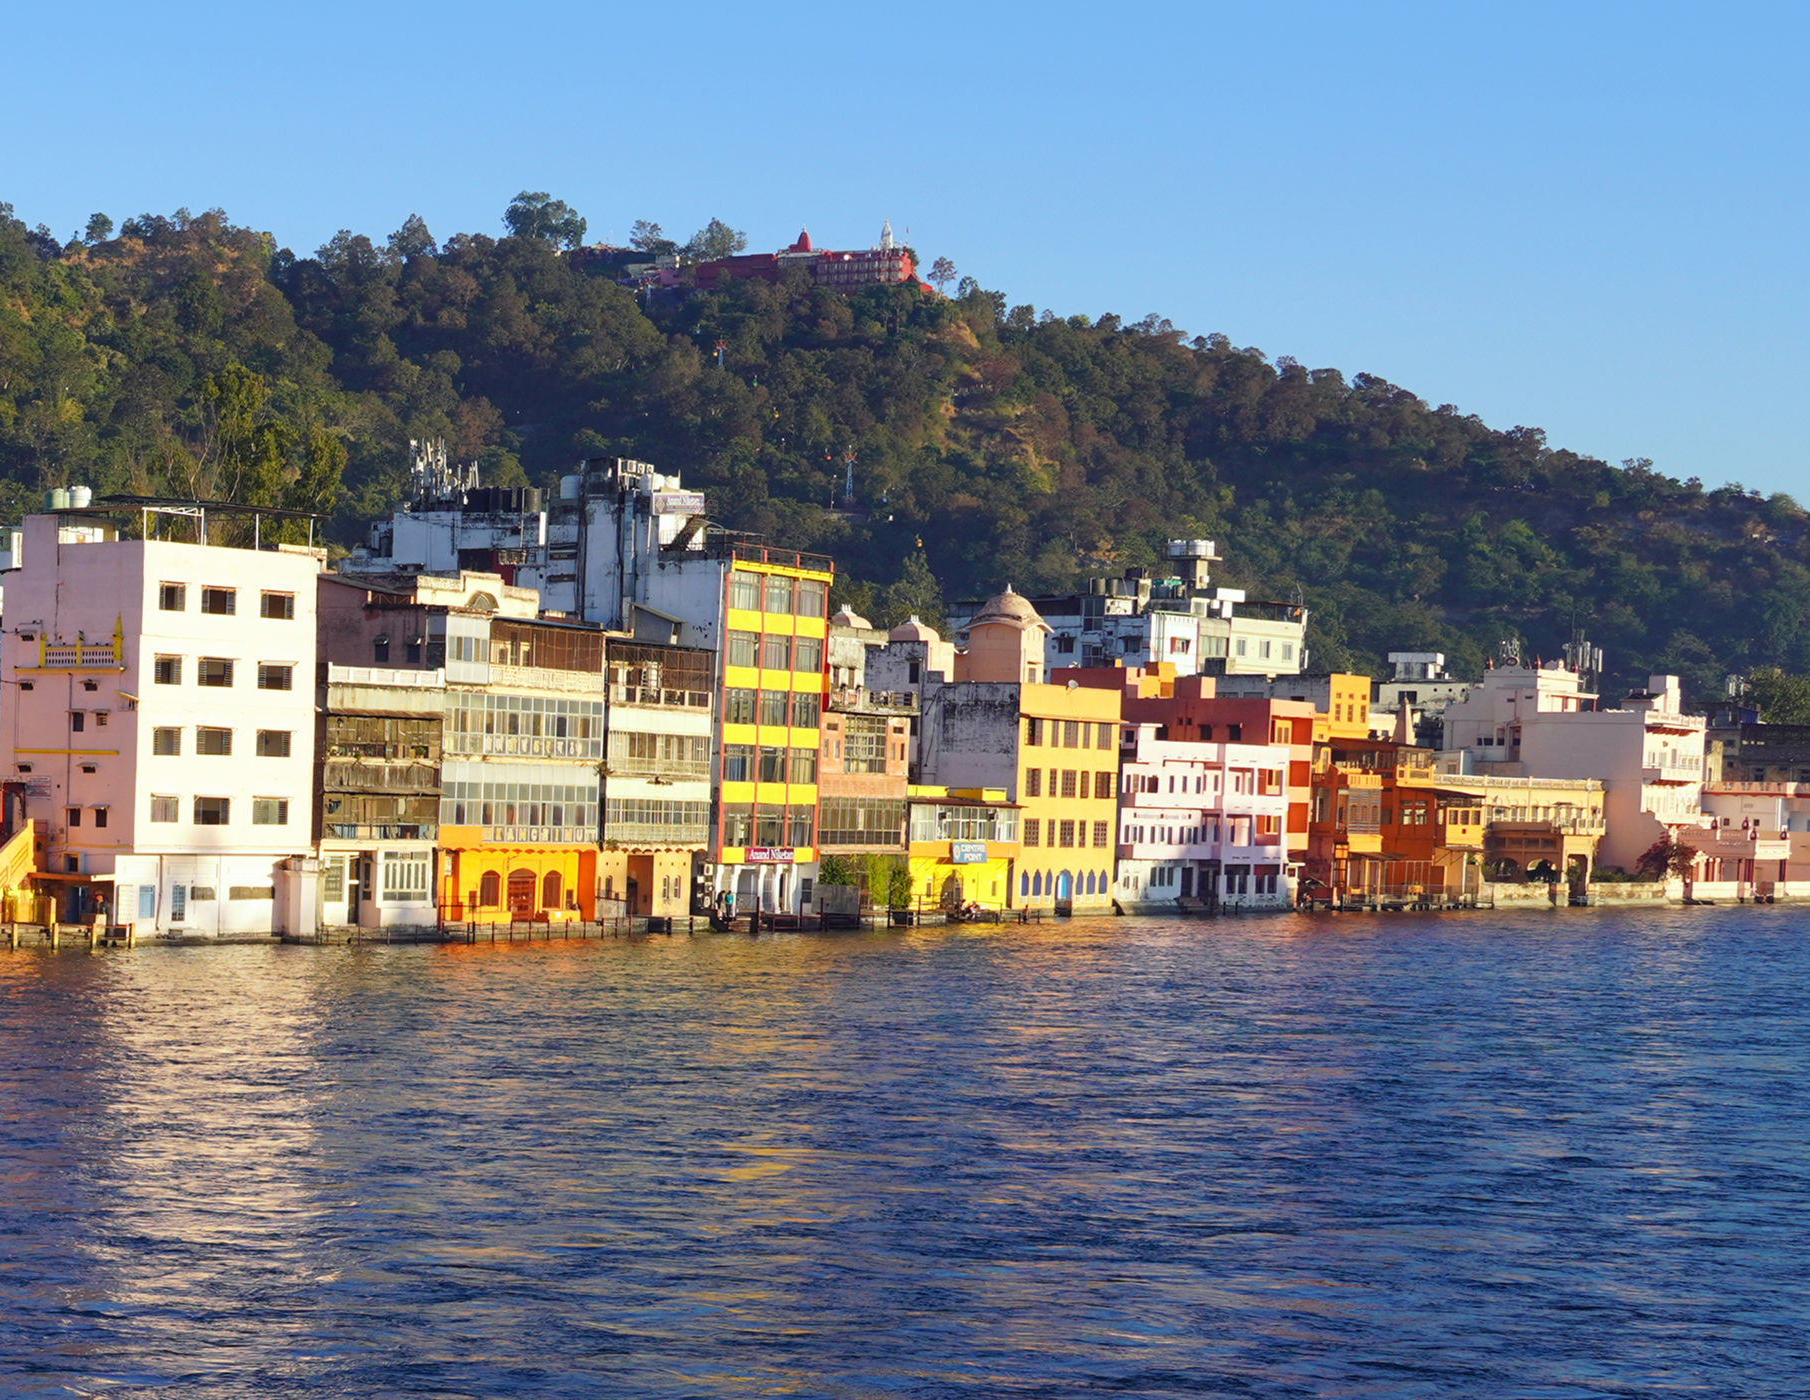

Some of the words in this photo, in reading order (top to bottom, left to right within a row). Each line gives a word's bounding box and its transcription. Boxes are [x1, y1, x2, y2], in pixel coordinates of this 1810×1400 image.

[961, 844, 986, 853] CENTRE
[750, 849, 770, 860] Anand
[770, 849, 794, 860] Niketan
[964, 853, 983, 862] POINT
